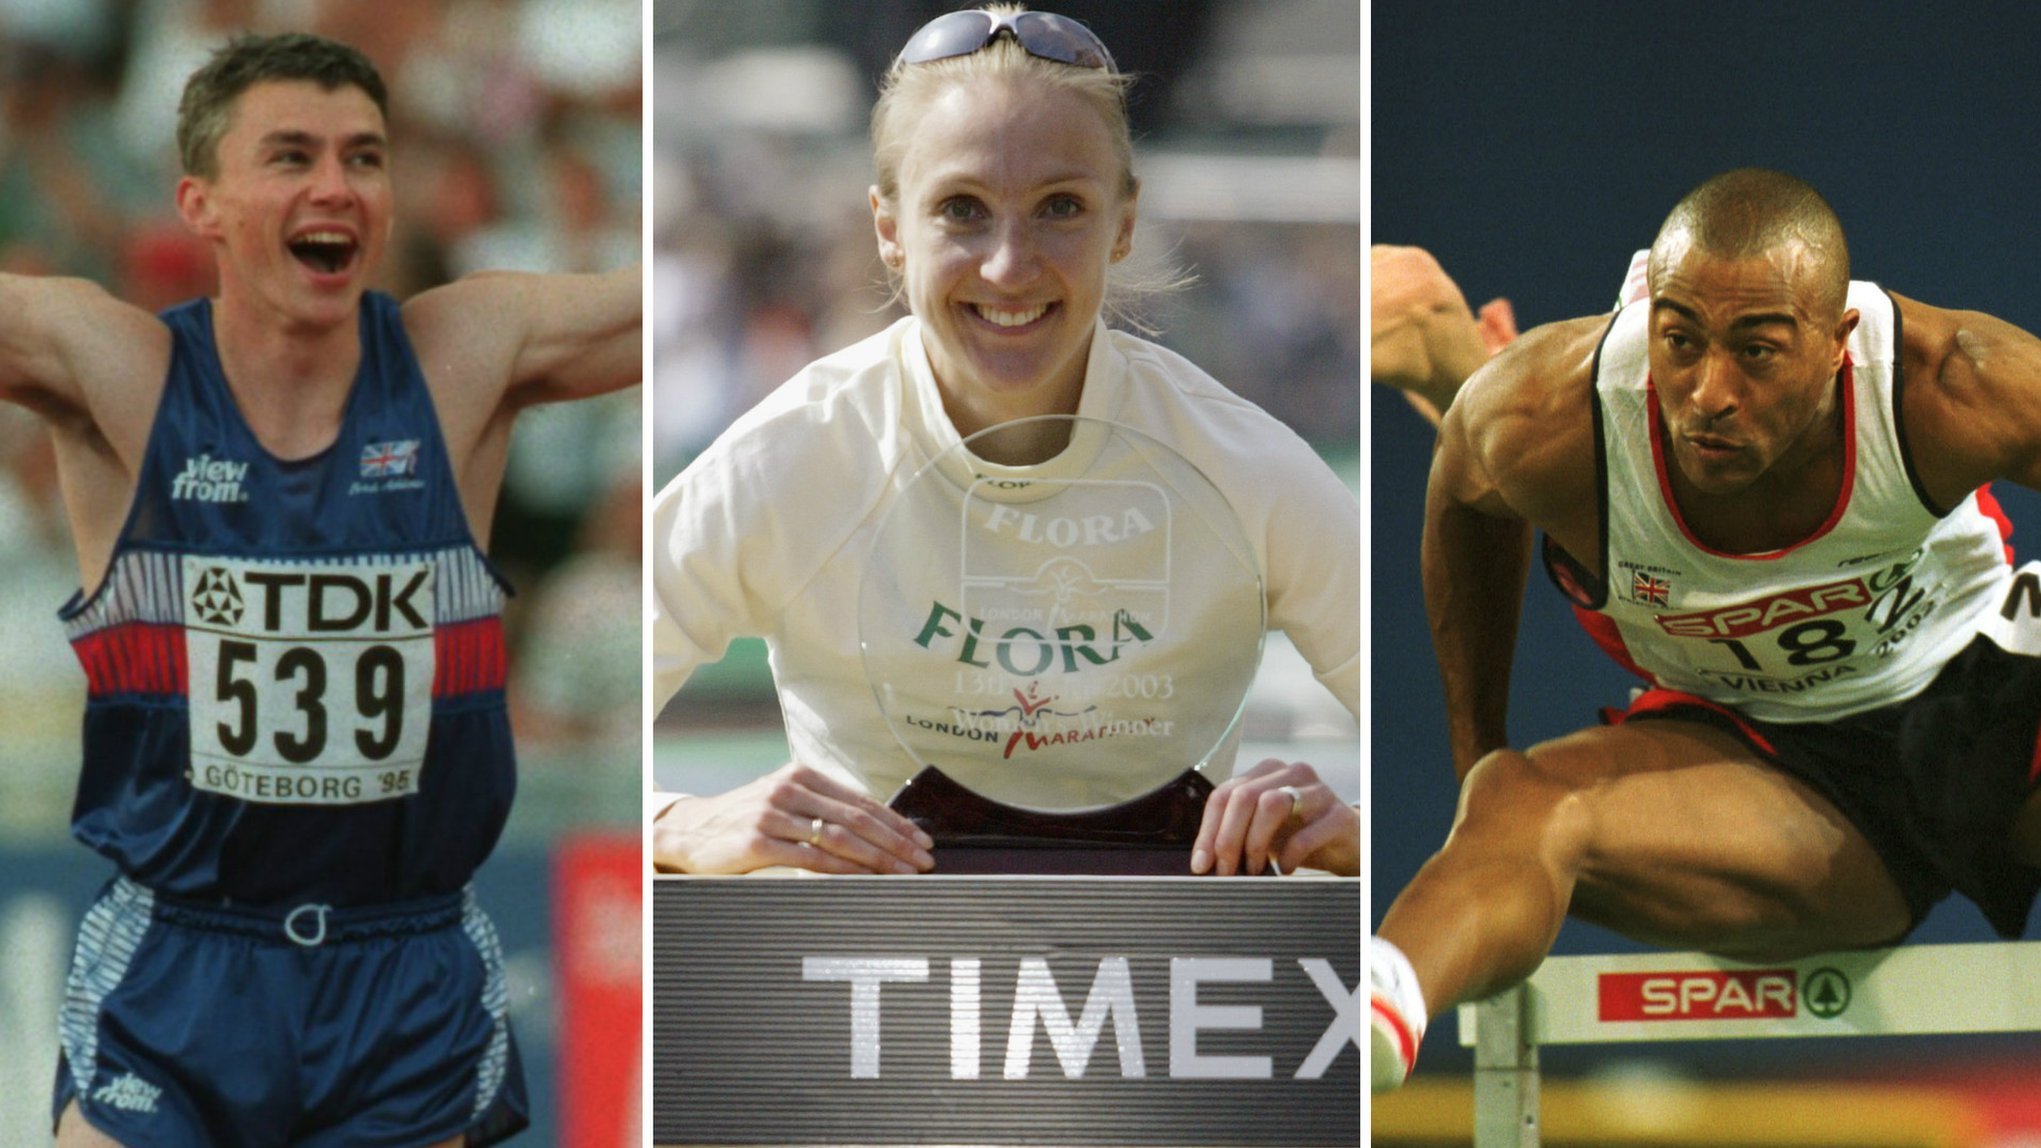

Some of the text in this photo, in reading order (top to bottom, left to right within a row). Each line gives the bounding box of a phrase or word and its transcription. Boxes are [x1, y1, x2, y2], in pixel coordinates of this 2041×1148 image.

[186, 453, 249, 481] view
[984, 503, 1155, 548] FLORA
[244, 569, 430, 632] TDK
[1662, 583, 1866, 637] SPAR
[913, 600, 1154, 676] FLORA
[1105, 673, 1174, 700] 2003
[1720, 664, 1857, 694] VIENNA
[216, 639, 405, 764] 539
[906, 714, 999, 744] LONDON
[205, 764, 362, 799] GÖTEBORG
[1641, 976, 1794, 1015] SPAR
[802, 957, 1361, 1080] TIMEX
